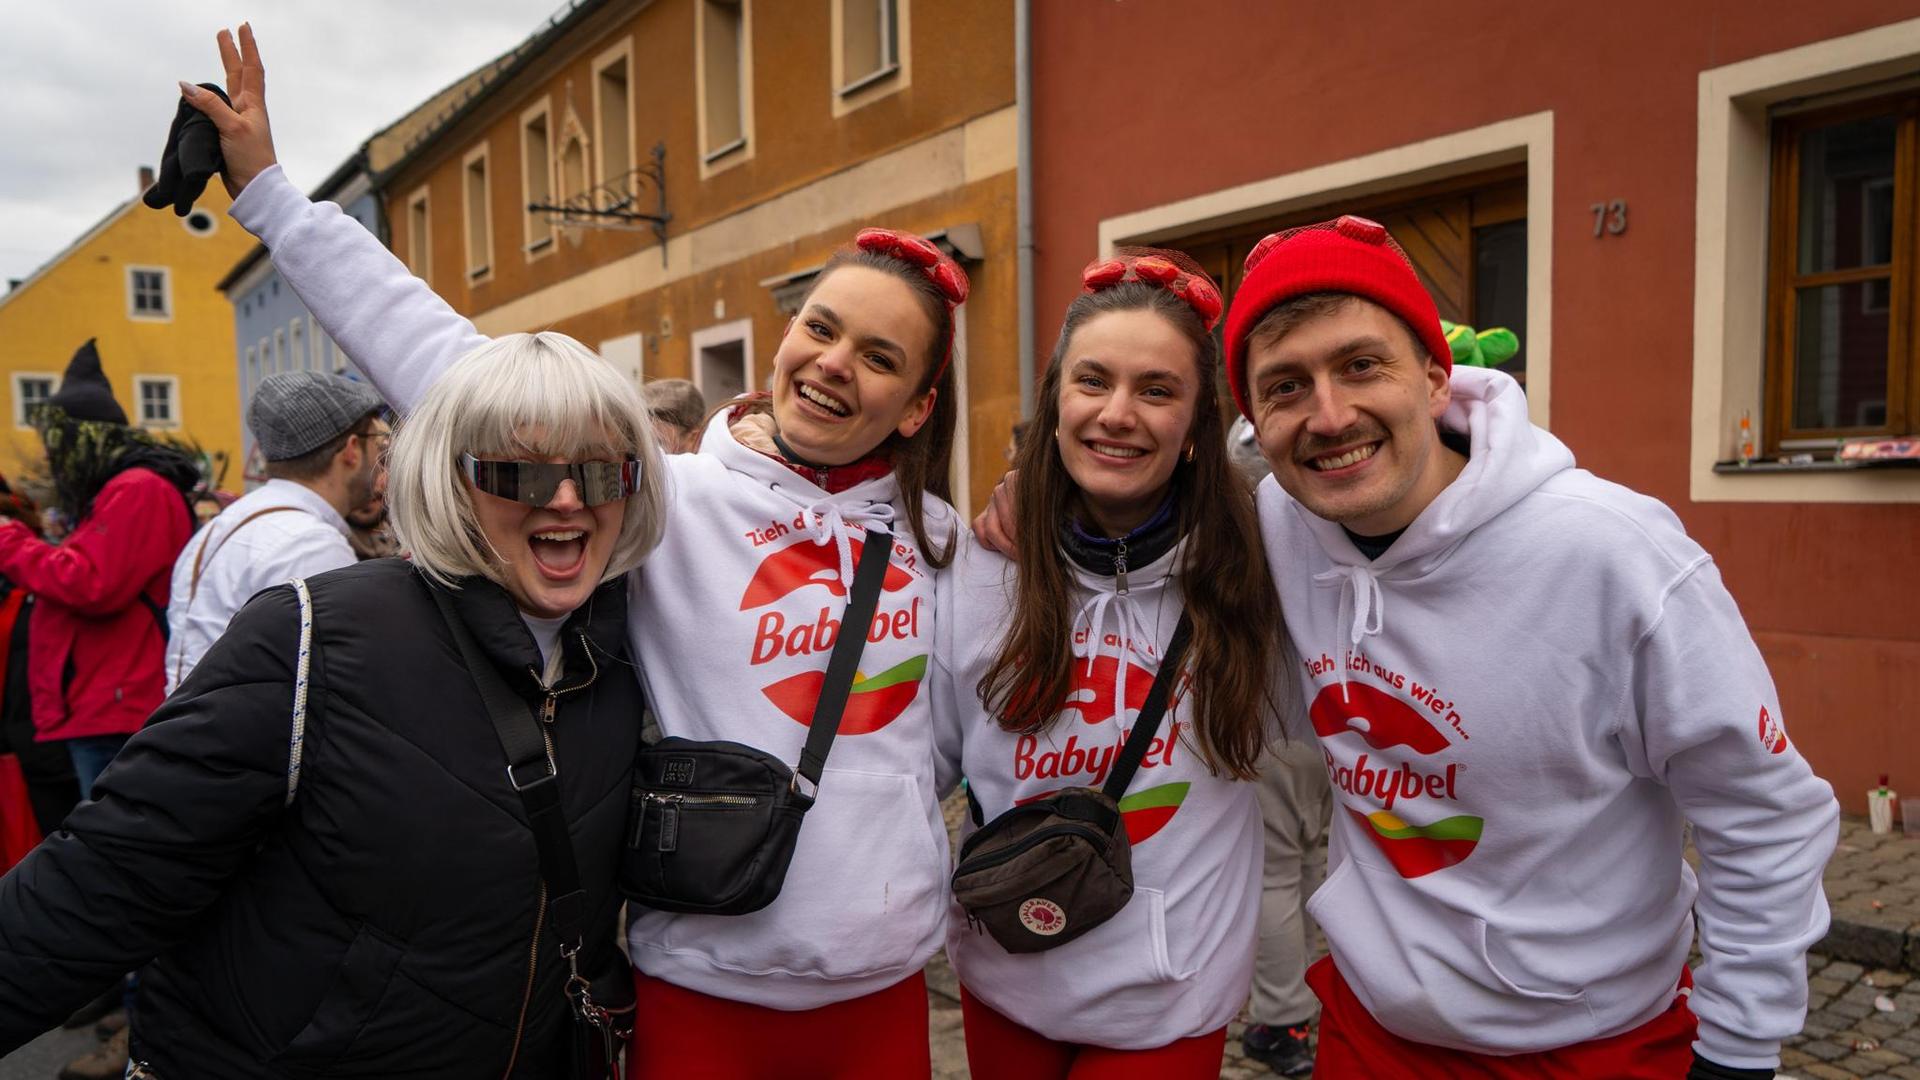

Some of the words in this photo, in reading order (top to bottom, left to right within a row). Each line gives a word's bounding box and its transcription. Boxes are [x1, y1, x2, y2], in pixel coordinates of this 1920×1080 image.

[1590, 198, 1626, 236] 73
[745, 520, 789, 547] Zieh
[750, 597, 919, 665] Babbel
[1374, 664, 1405, 690] aus
[1410, 682, 1470, 740] wie'n...
